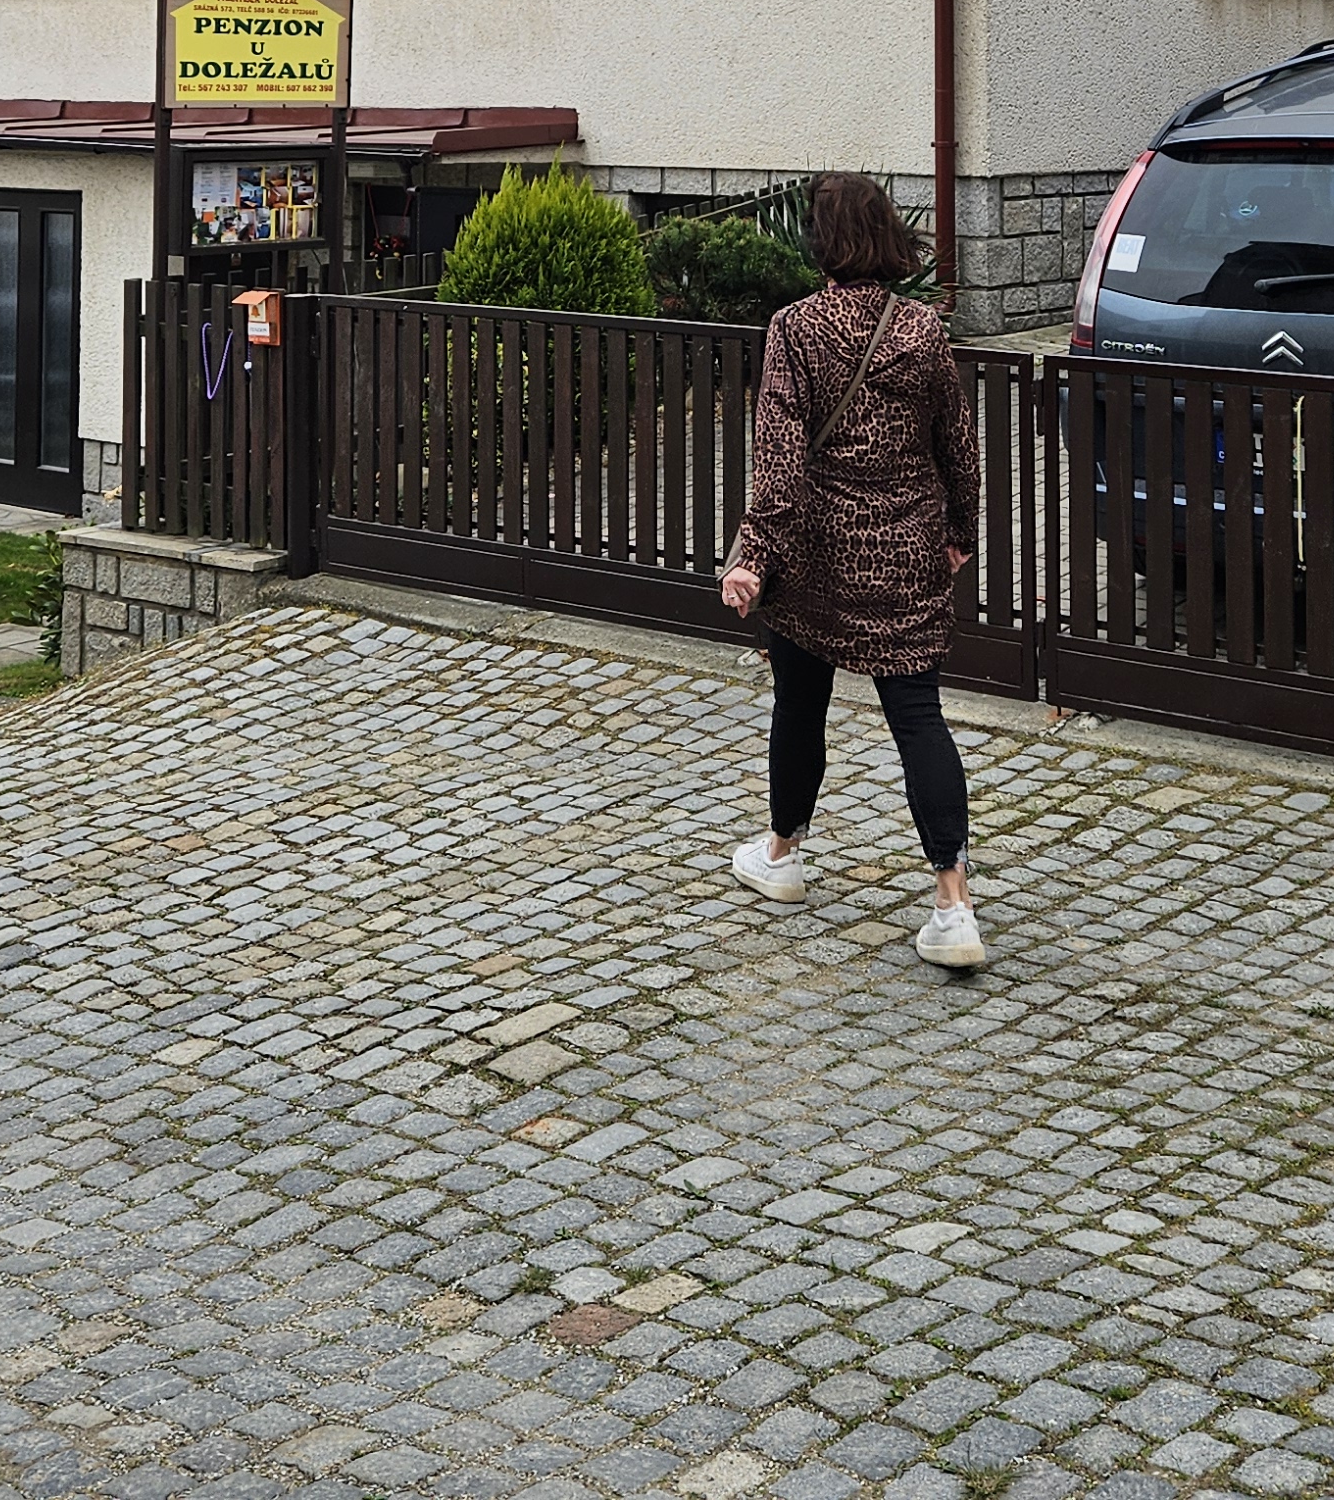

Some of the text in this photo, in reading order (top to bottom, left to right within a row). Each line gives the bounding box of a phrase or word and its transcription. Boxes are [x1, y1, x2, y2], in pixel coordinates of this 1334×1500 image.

[193, 17, 324, 37] PENZION
[250, 41, 265, 55] U
[178, 57, 334, 80] DOLEŽALŮ
[1100, 339, 1166, 356] CITROËN
